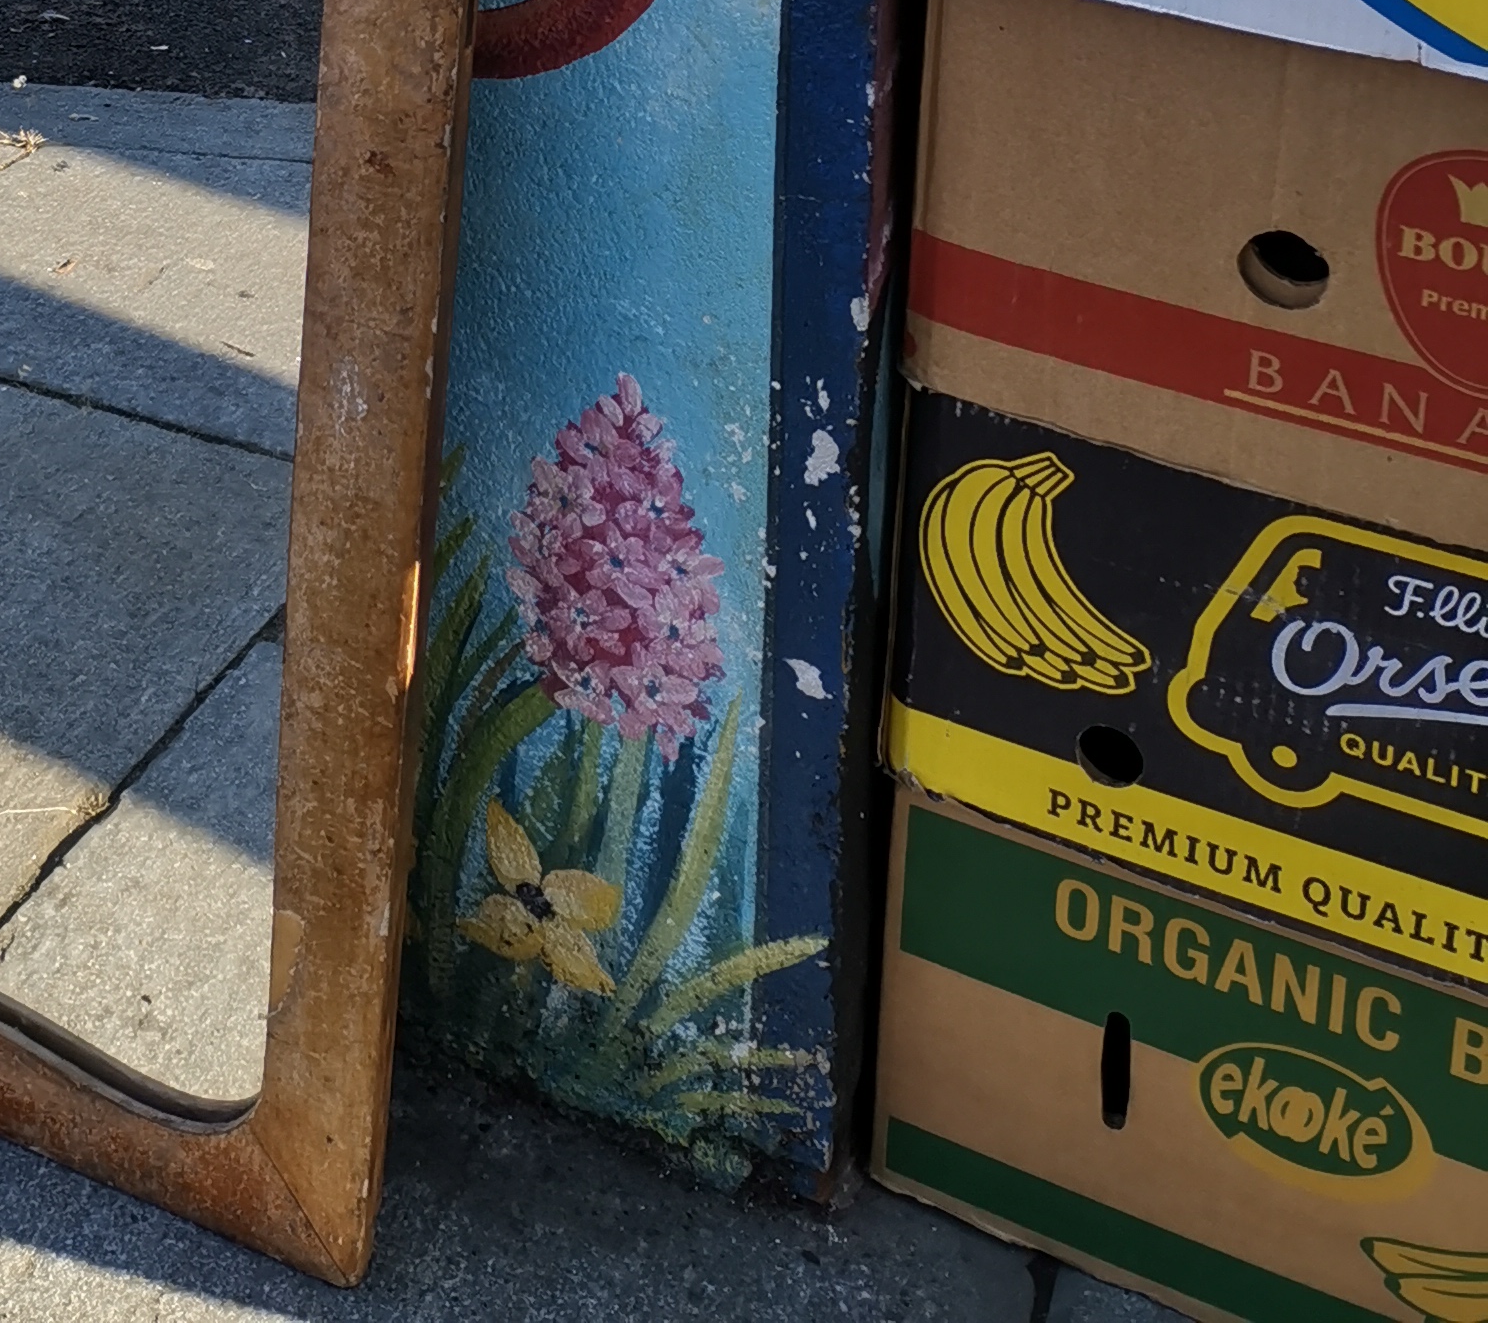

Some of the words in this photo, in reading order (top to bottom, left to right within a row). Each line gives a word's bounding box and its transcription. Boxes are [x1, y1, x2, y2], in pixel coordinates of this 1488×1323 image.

[1397, 224, 1488, 276] BO
[1046, 787, 1284, 895] PREMIUM
[1055, 879, 1402, 1052] ORGANIC
